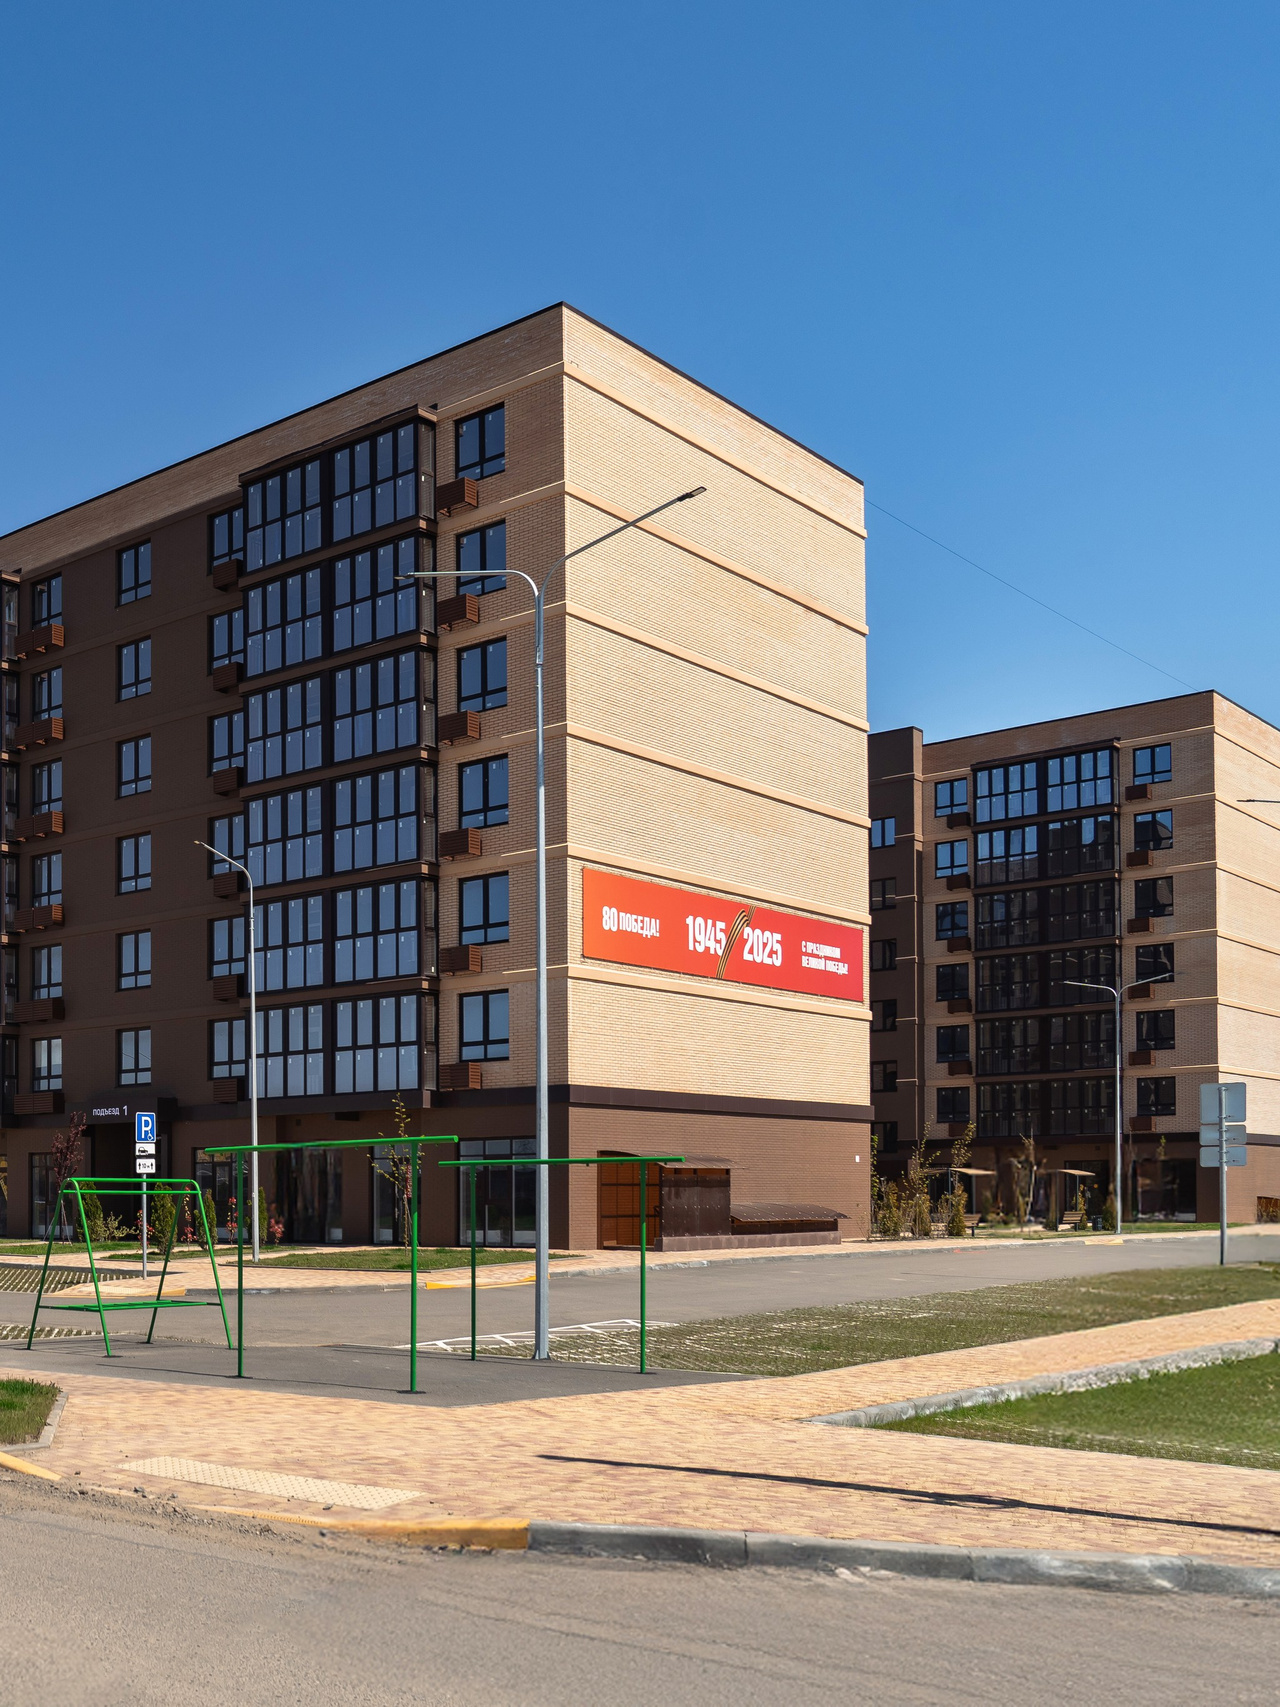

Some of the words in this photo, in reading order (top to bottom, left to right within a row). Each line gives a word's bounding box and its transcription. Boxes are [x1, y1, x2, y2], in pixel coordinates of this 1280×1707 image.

[602, 906, 618, 932] 80
[619, 912, 660, 938] ПОБЕДА!
[685, 915, 727, 957] 1945
[743, 926, 783, 967] 2025
[122, 1105, 128, 1115] 1
